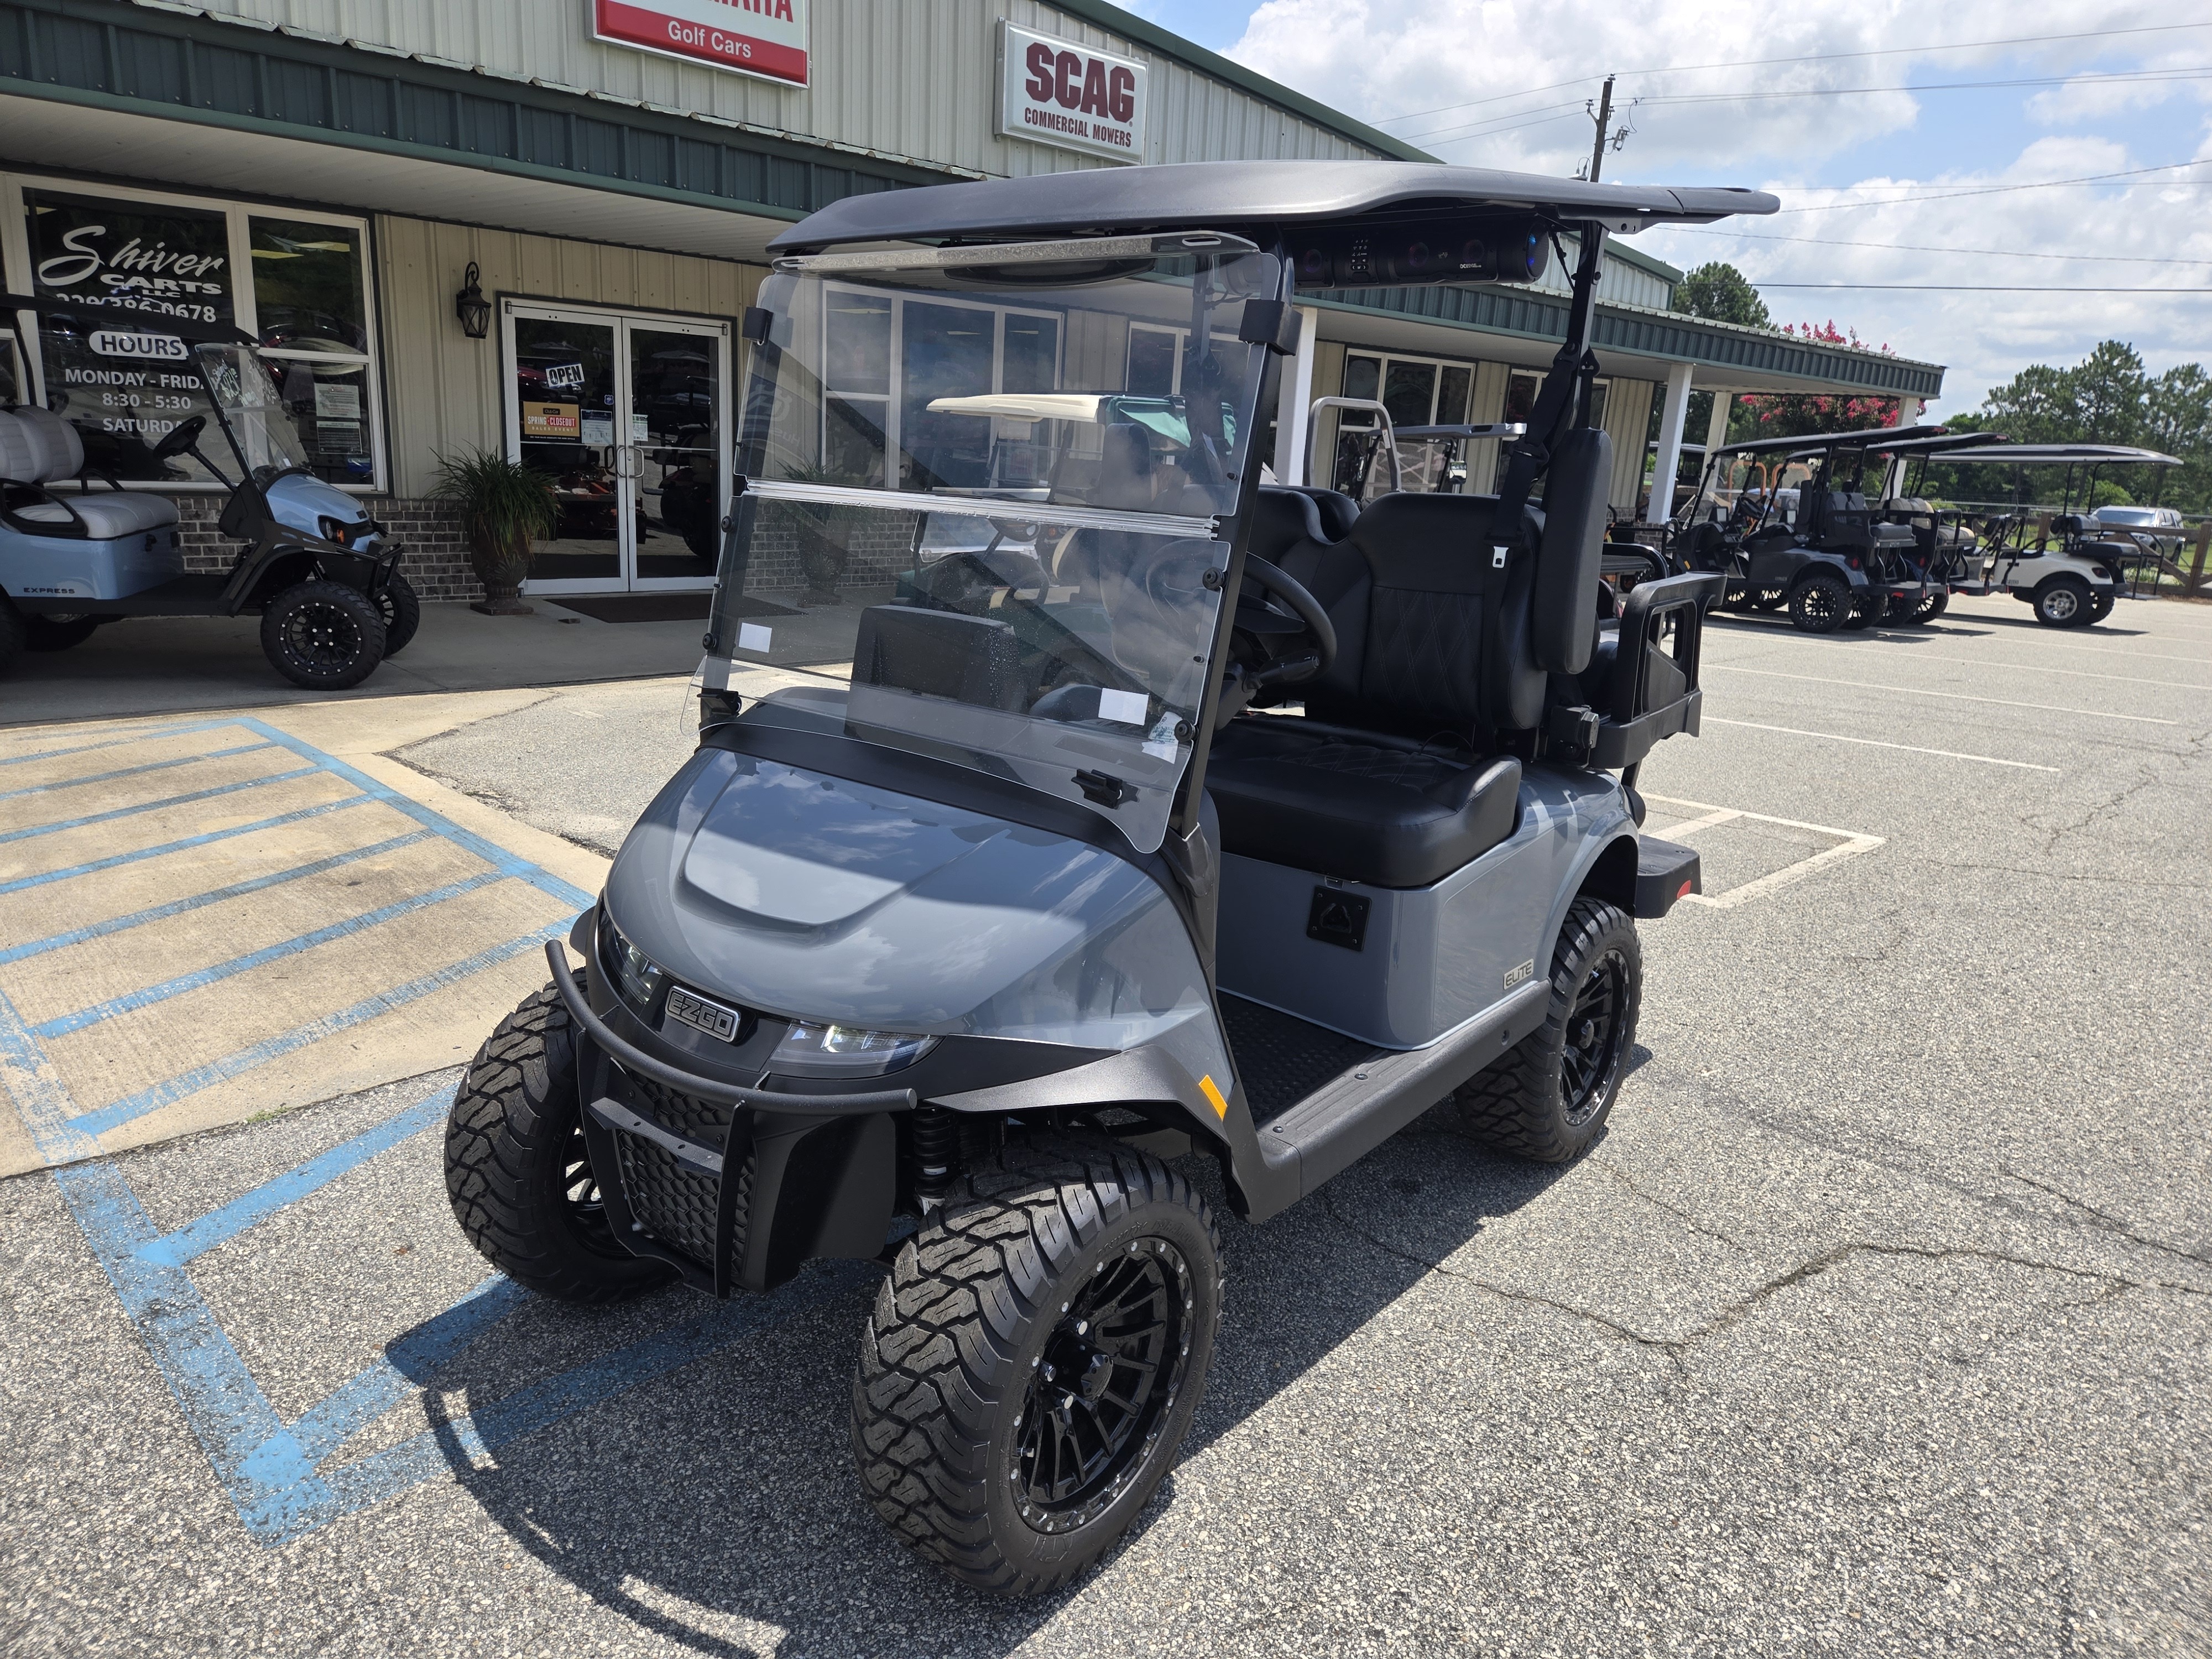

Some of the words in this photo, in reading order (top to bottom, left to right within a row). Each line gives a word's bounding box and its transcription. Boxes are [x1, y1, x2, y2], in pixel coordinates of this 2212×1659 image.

[668, 20, 705, 46] Golf
[711, 32, 752, 58] Cars
[1025, 42, 1135, 123] SCAG
[1025, 107, 1089, 138] COMMERCIAL
[1093, 123, 1131, 148] MOWERS
[38, 225, 225, 286] Shiver
[100, 274, 222, 295] CARTS
[142, 289, 181, 298] LLC
[101, 335, 182, 356] HOURS
[65, 368, 147, 387] MONDAY
[549, 366, 582, 385] OPEN
[102, 393, 140, 407] 8:30
[155, 395, 191, 410] 5:30
[528, 416, 547, 425] SPRING
[550, 417, 575, 427] CLOSEOUT
